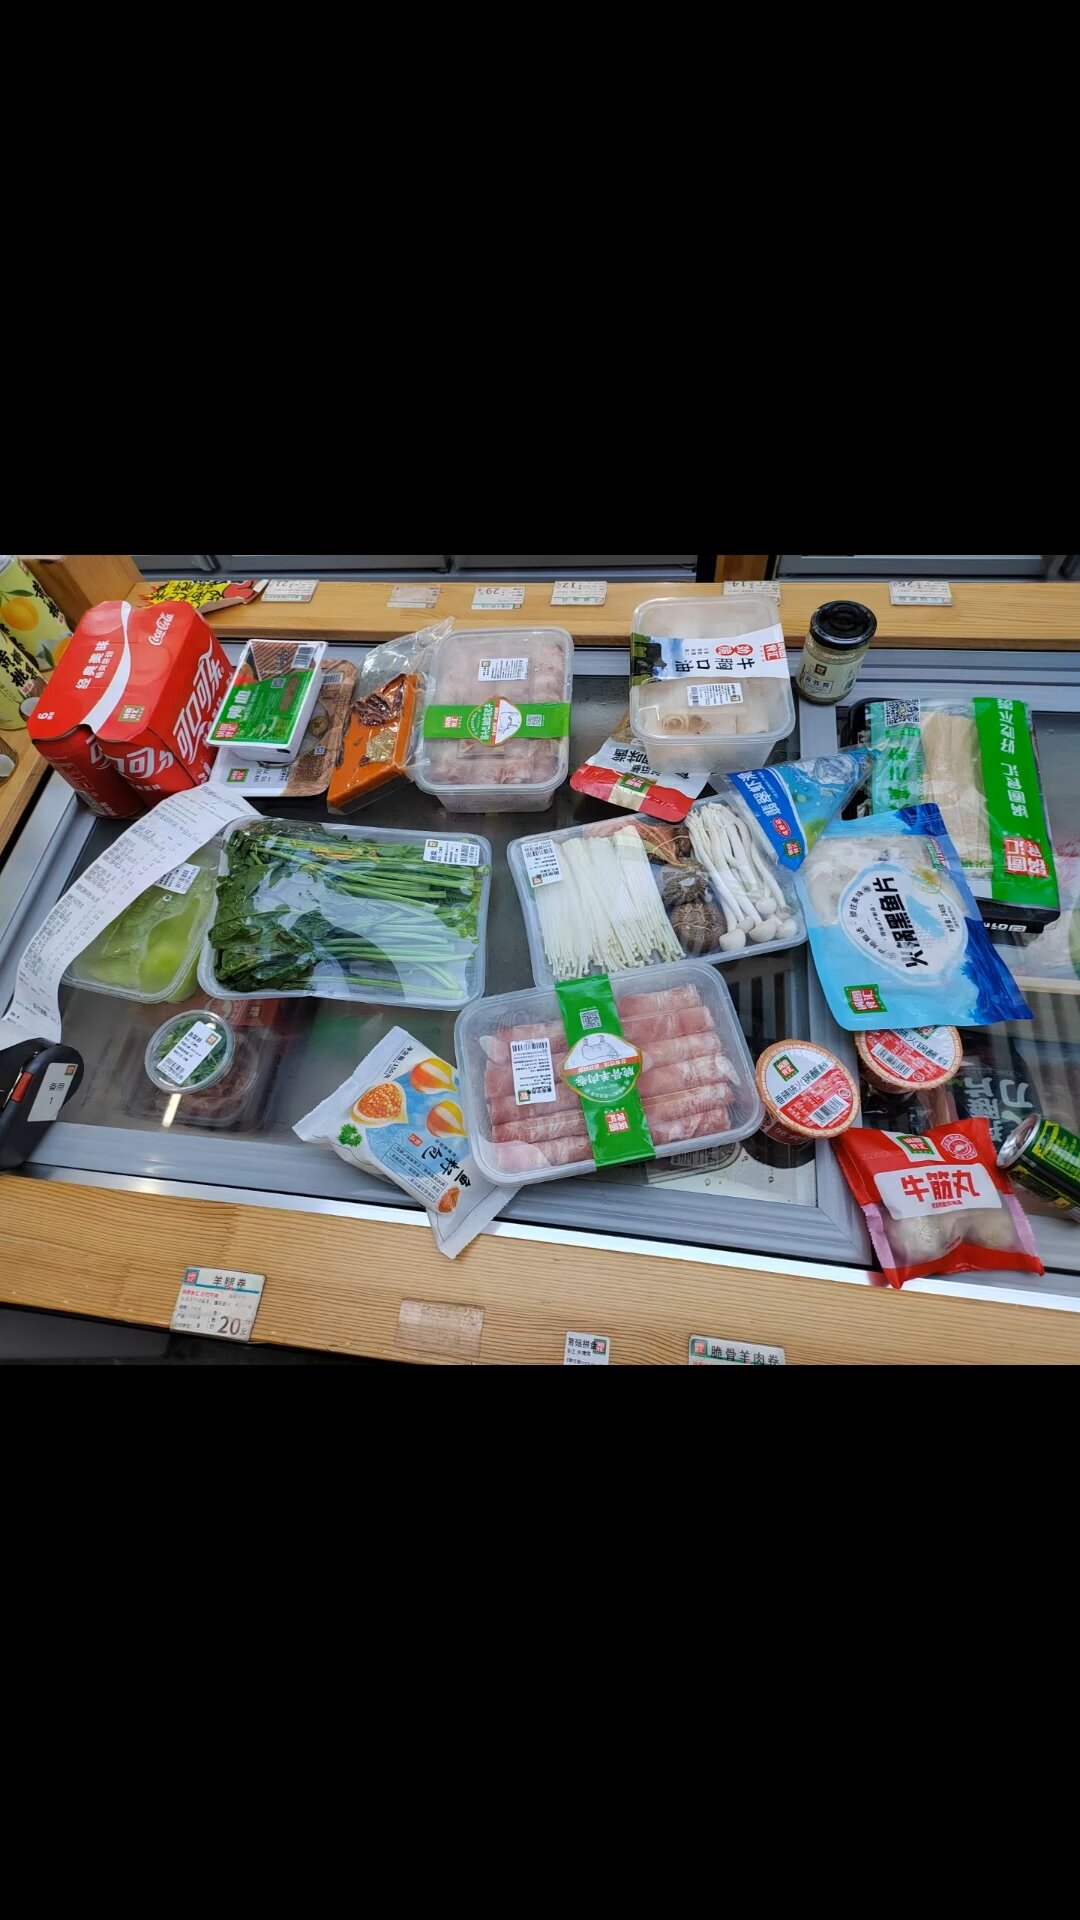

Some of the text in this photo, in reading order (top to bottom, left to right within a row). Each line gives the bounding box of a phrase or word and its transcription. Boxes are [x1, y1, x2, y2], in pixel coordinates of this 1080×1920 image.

[486, 587, 501, 595] 29
[75, 640, 111, 689] 经典美味
[173, 636, 225, 764] 可口可乐
[226, 689, 250, 721] 鸭血
[997, 699, 1015, 755] 好吃不贵
[737, 770, 782, 818] 翡翠虾滑
[1001, 762, 1028, 819] 锅圈食汇
[1003, 837, 1049, 878] 锅圈食汇
[872, 877, 928, 968] 火锅黑鱼片
[605, 1110, 629, 1133] 锅圈食汇
[902, 1137, 933, 1154] 锅圈食汇
[421, 1145, 472, 1188] 鱼籽包
[901, 1170, 981, 1202] 牛筋丸
[217, 1316, 241, 1336] 20
[710, 1345, 780, 1365] 脆骨羊肉卷
